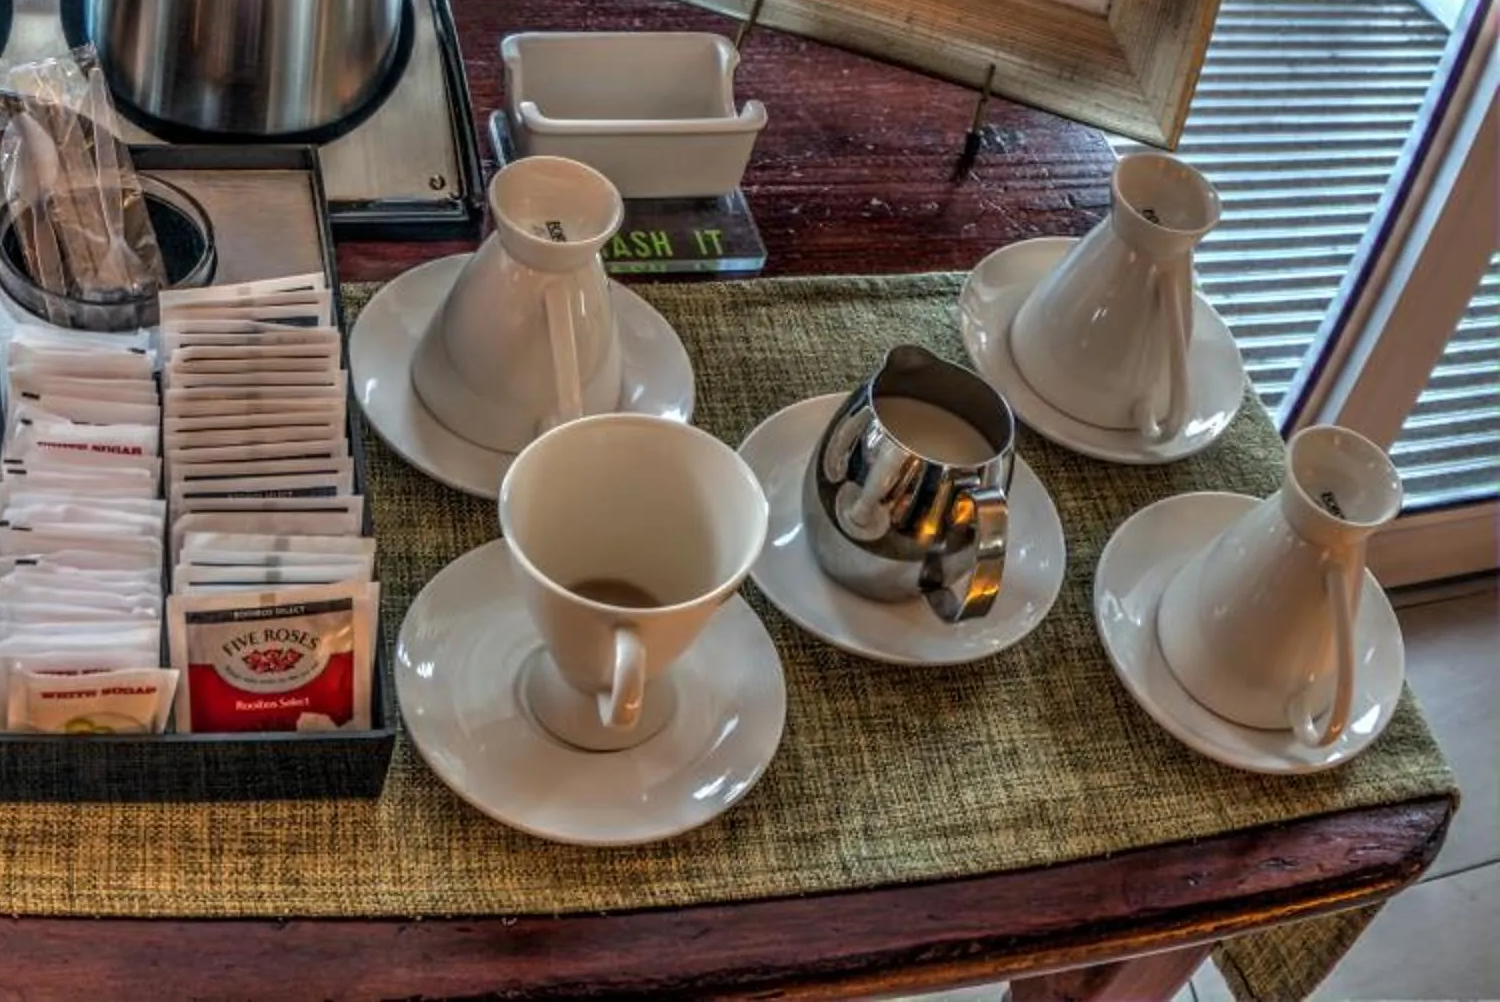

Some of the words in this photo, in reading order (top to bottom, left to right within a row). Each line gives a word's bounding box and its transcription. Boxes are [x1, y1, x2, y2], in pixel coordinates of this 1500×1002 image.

[602, 230, 674, 258] ASH
[693, 229, 724, 256] IT
[221, 630, 260, 657] FIVE
[263, 628, 321, 651] ROSES
